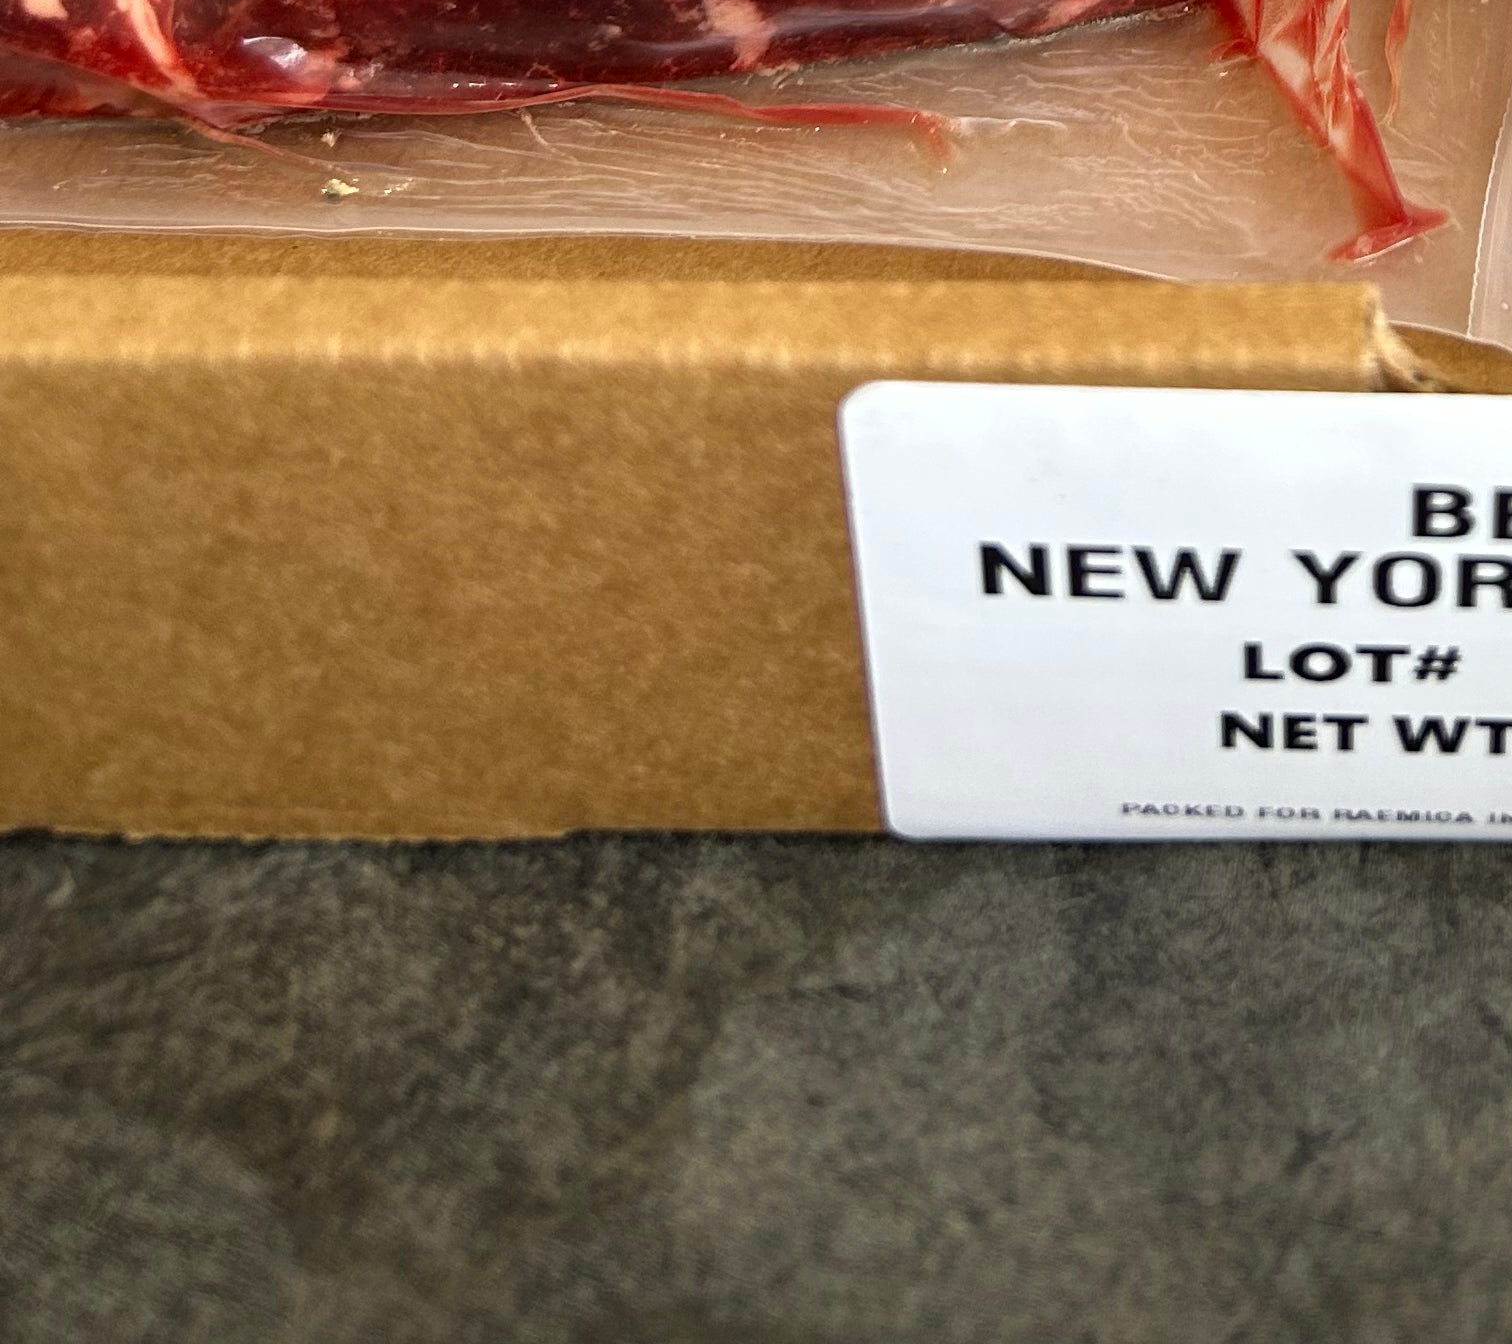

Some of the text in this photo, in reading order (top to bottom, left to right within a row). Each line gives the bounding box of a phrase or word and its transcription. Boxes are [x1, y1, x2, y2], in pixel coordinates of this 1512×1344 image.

[976, 541, 1243, 604] NEW
[1242, 641, 1464, 686] LOT#
[1219, 710, 1370, 754] NET
[1121, 802, 1244, 818] PACKED
[1258, 806, 1320, 820] FOR
